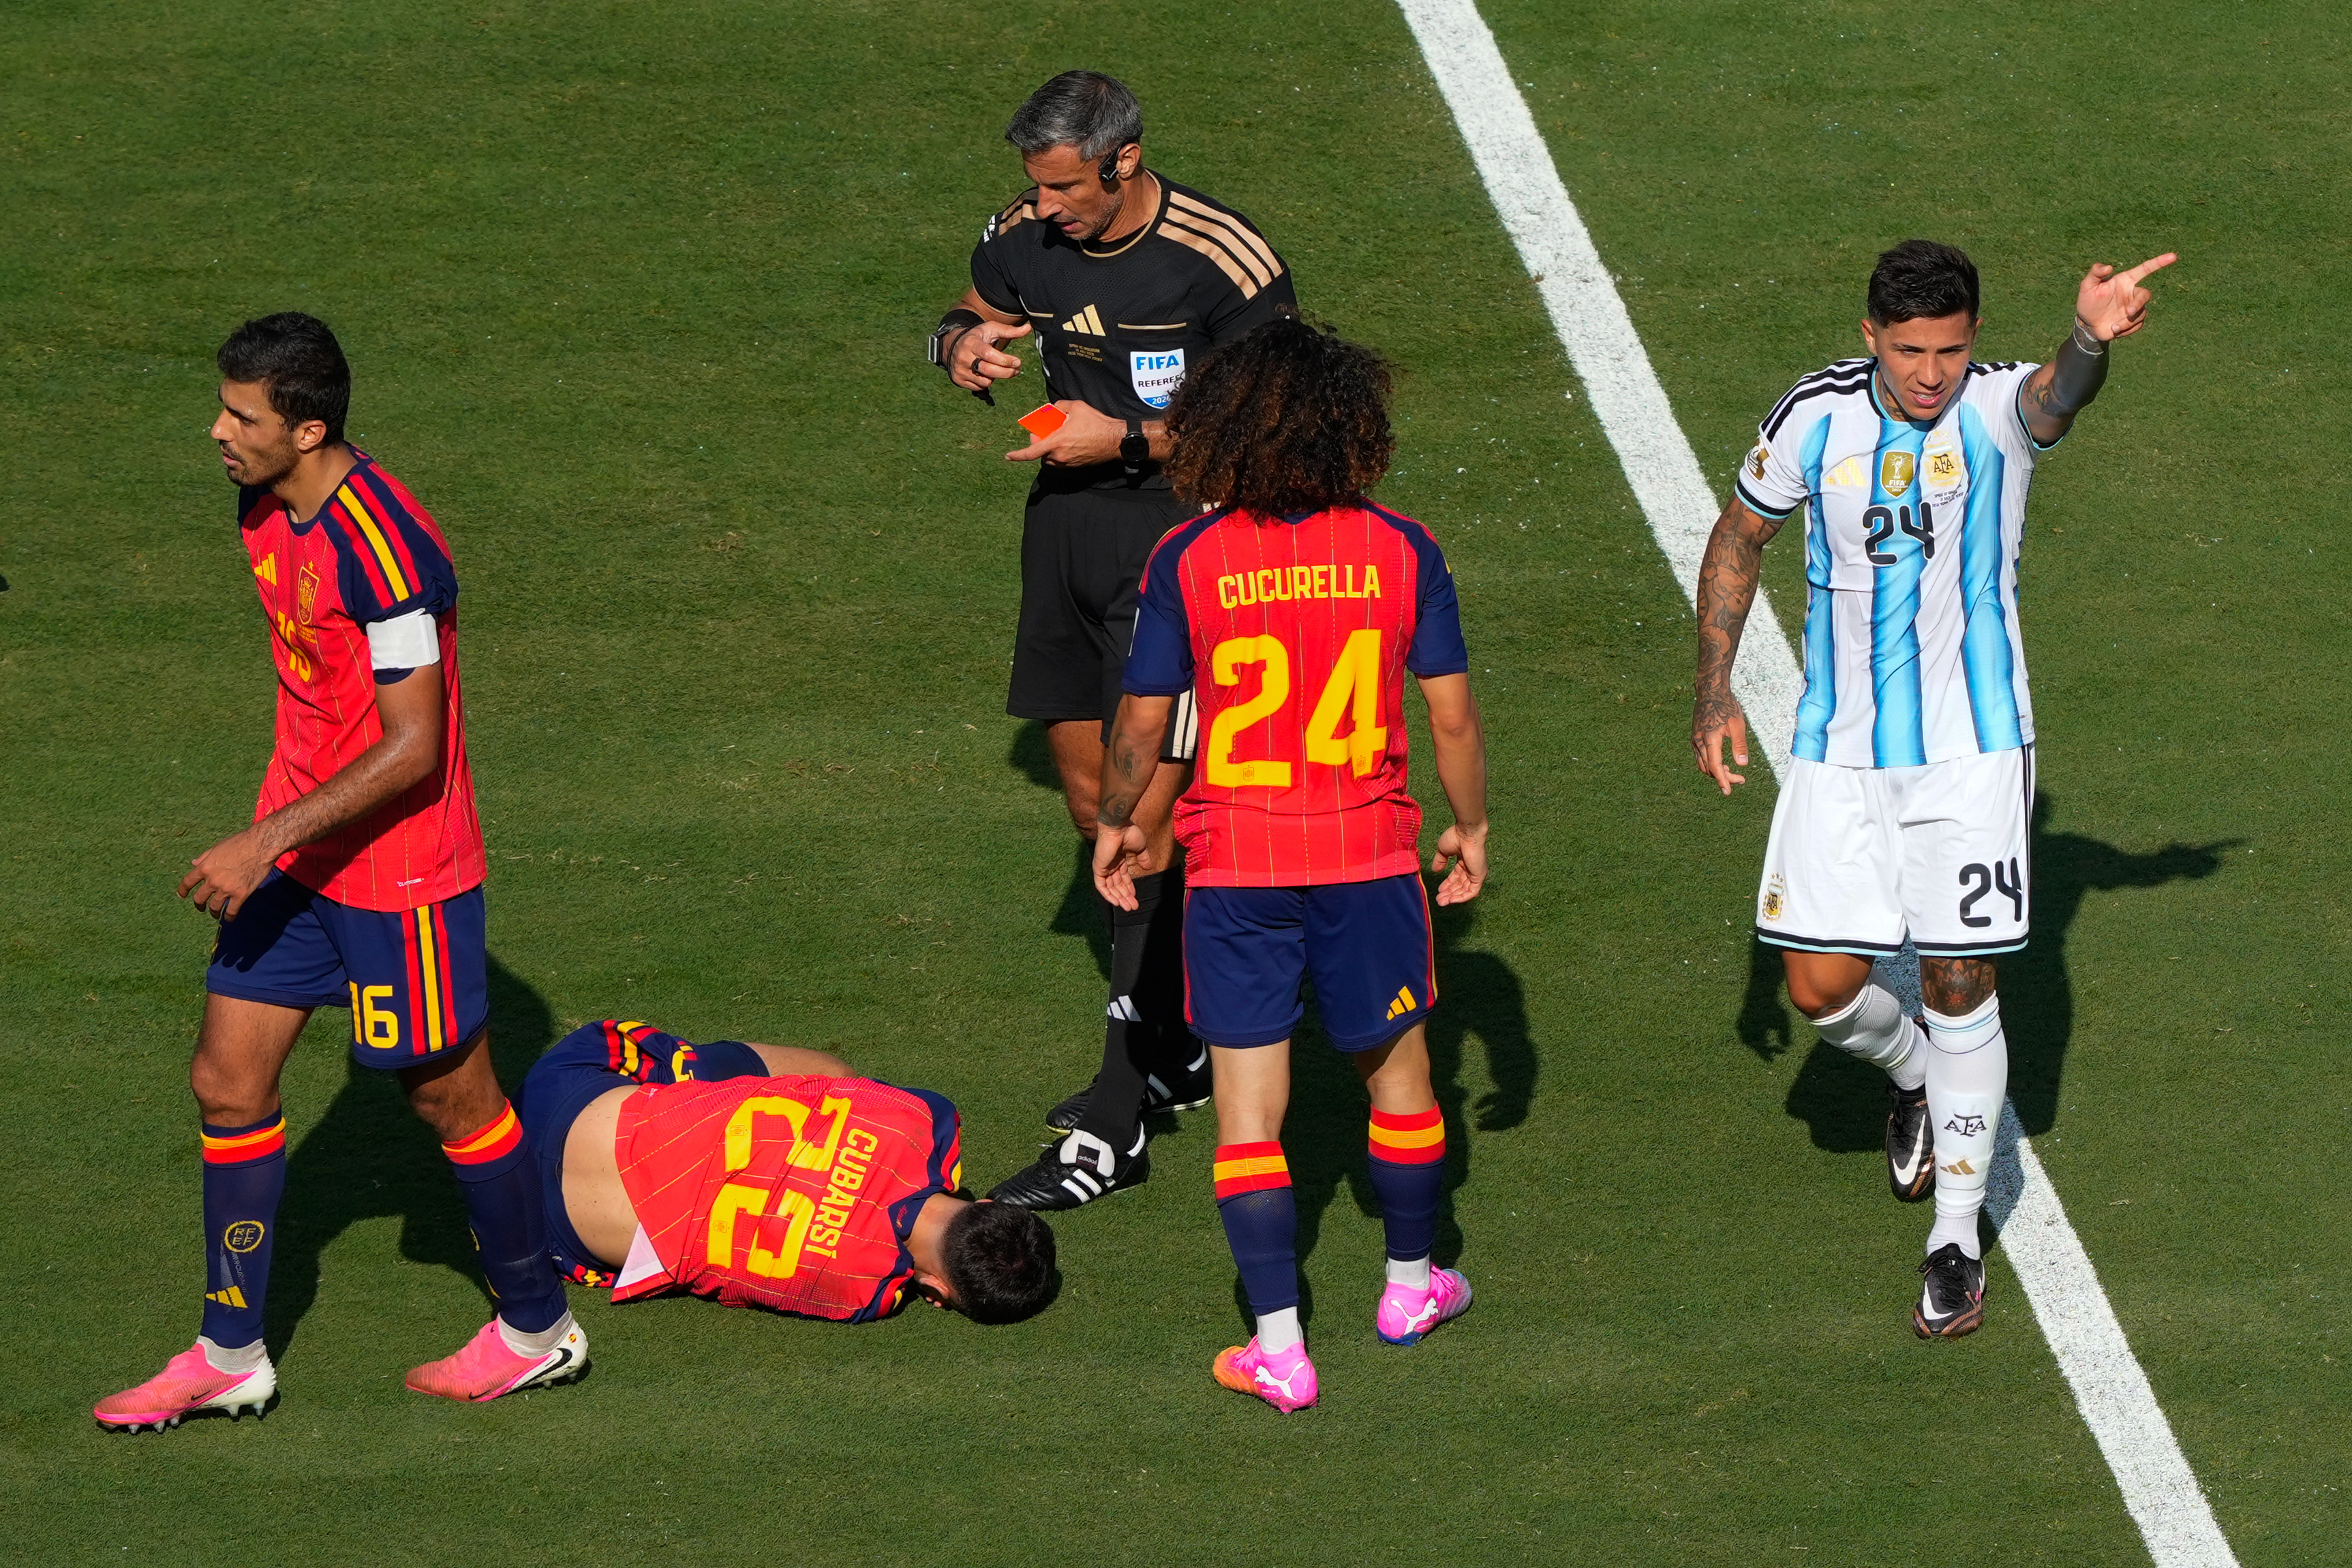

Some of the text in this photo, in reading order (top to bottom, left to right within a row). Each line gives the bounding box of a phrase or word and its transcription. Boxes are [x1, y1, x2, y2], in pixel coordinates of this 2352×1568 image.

[1136, 354, 1180, 370] FIFA
[1934, 453, 1955, 474] AFA
[1863, 502, 1935, 566] 24
[1218, 564, 1381, 609] CUCURELLA
[1207, 628, 1388, 788] 24
[1959, 857, 2022, 927] 24
[349, 980, 399, 1049] 16
[1944, 1113, 1987, 1137] AFA
[707, 1094, 852, 1279] 22
[805, 1128, 879, 1259] CUBARSÍ
